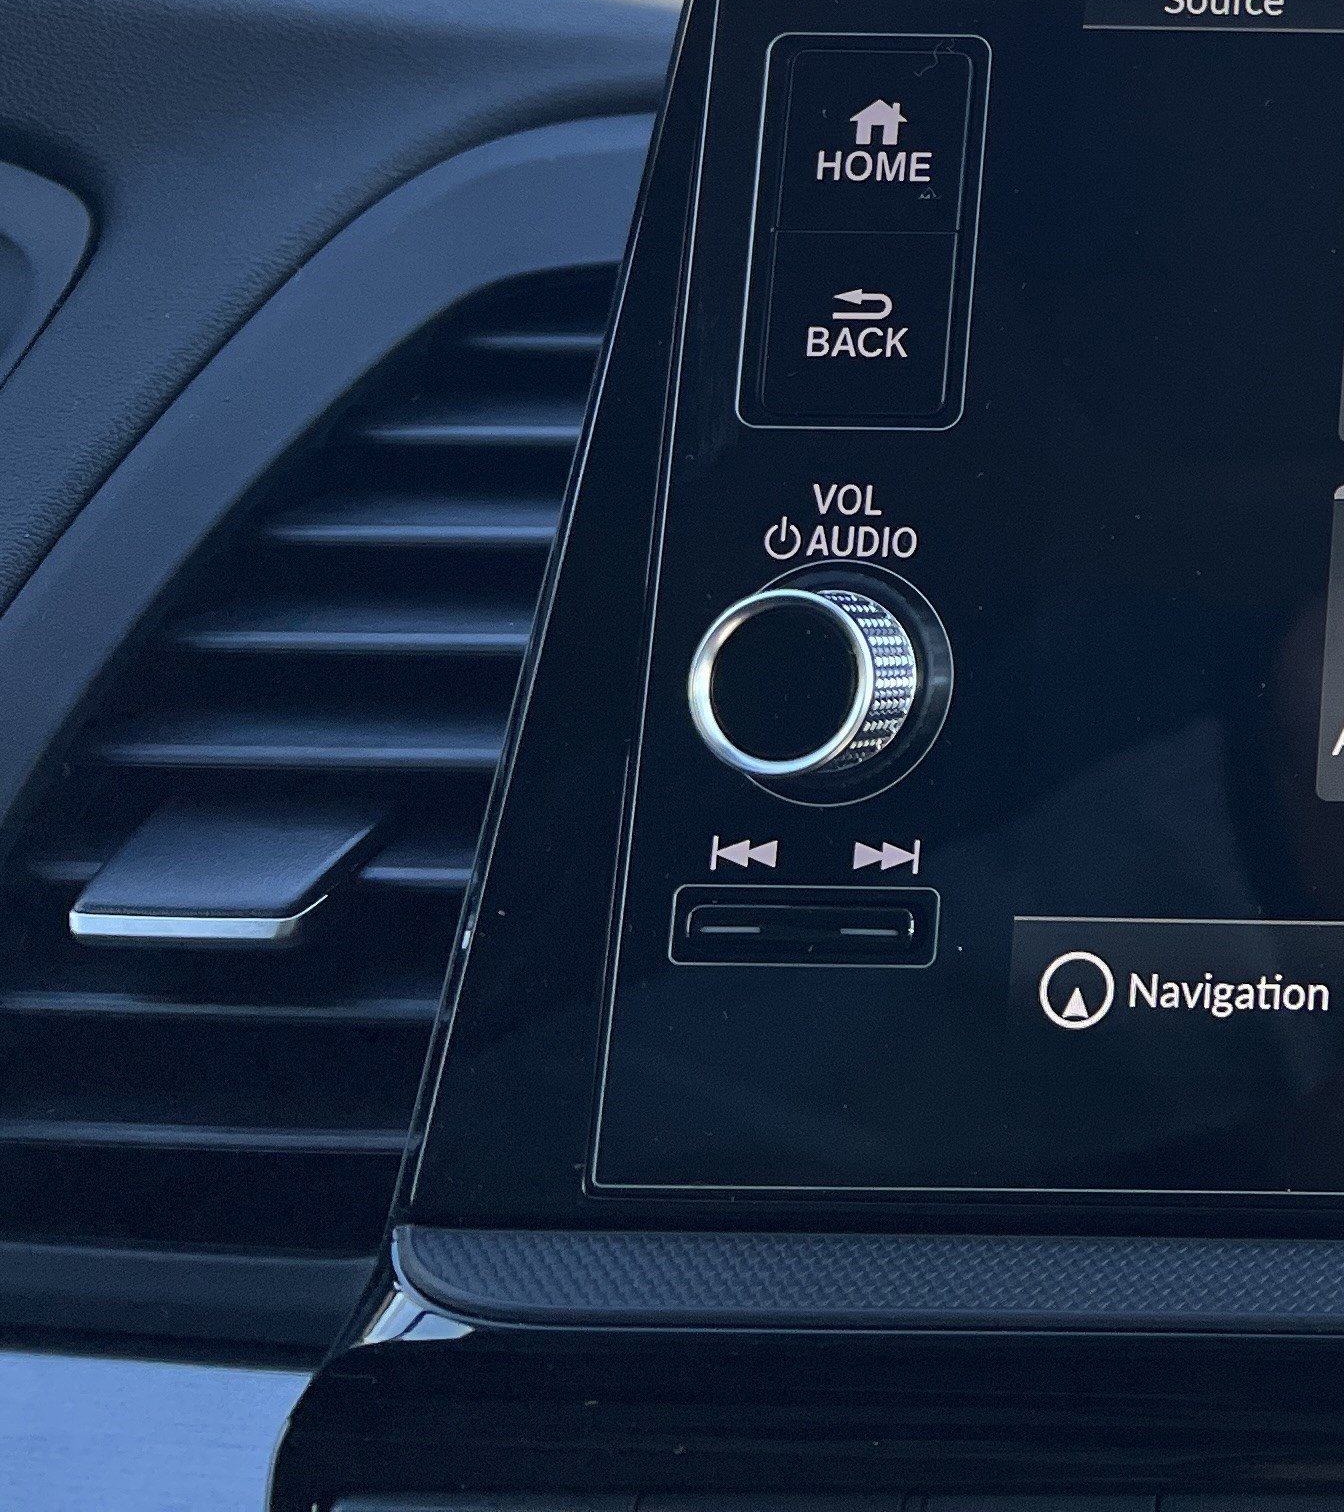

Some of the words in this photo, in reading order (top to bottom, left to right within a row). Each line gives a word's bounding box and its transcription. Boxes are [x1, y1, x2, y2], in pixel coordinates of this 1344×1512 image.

[816, 150, 933, 182] HOME
[806, 326, 909, 358] BACK
[812, 483, 882, 516] VOL
[806, 525, 918, 558] AUDIO
[1128, 972, 1330, 1015] Navigation
